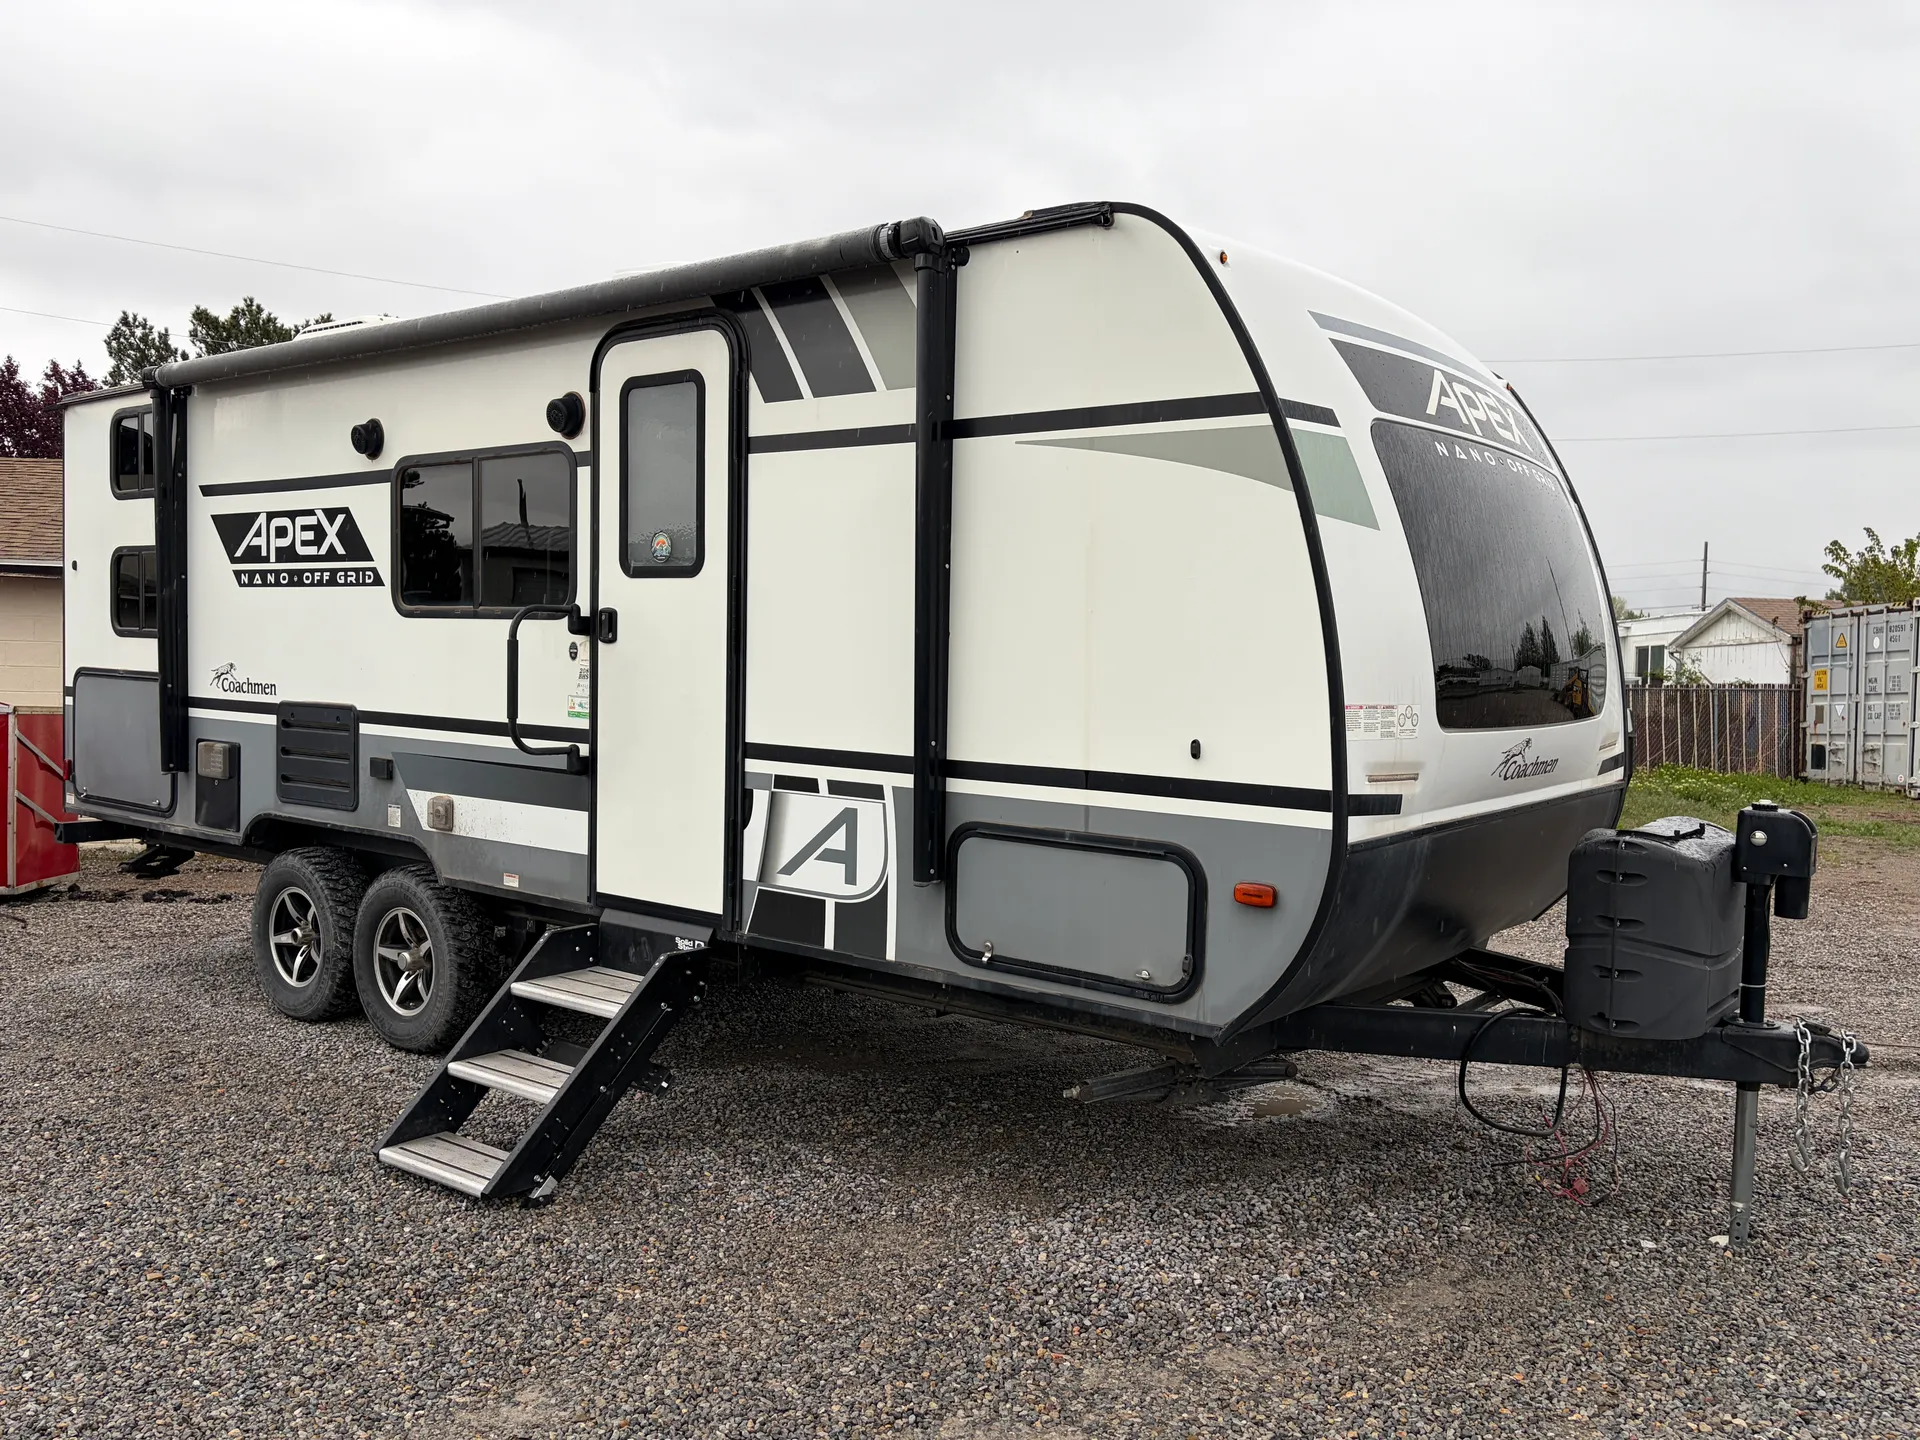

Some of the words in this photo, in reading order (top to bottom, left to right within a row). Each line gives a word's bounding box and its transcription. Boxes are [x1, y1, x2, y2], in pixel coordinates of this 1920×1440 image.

[1425, 369, 1533, 452] APEX
[1434, 441, 1496, 466] NANO
[1506, 458, 1530, 476] OFF
[233, 508, 347, 563] APEX
[241, 572, 289, 585] NANO
[303, 571, 331, 584] OFF
[336, 570, 374, 584] GRID
[221, 676, 277, 696] Coachmen
[1502, 756, 1559, 781] Coachmen
[776, 806, 858, 887] A
[674, 936, 694, 947] Solid
